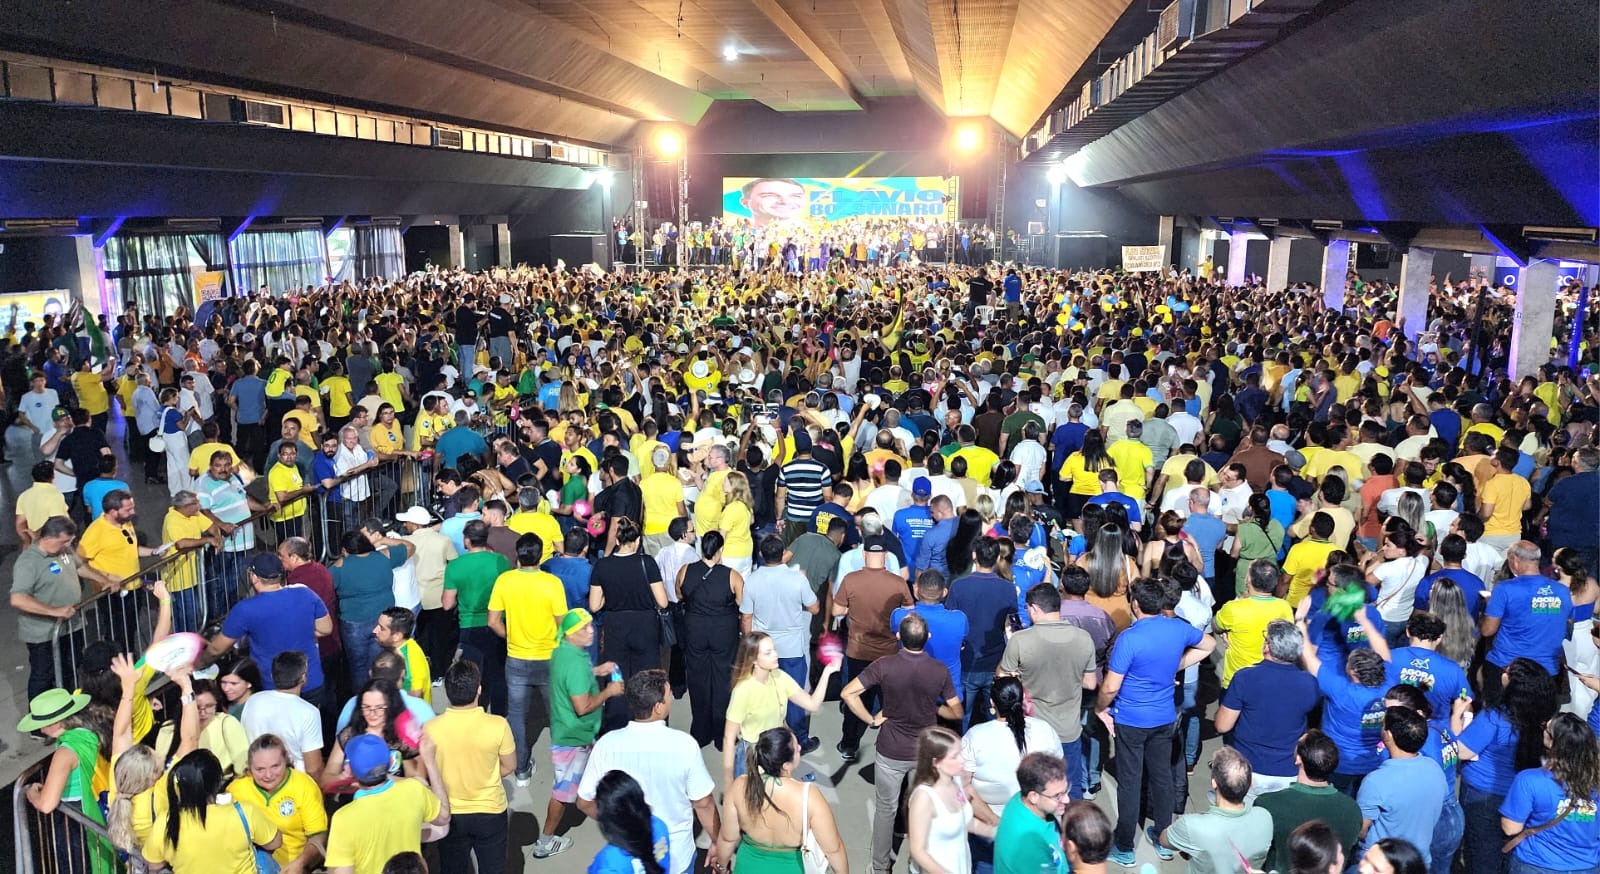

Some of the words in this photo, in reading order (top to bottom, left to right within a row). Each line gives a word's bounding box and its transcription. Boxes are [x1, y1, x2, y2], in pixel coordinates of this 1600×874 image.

[810, 188, 943, 202] FLÁVIO
[810, 203, 944, 215] BOSONARO
[1401, 668, 1434, 682] AGORA
[1362, 711, 1386, 720] AGOR
